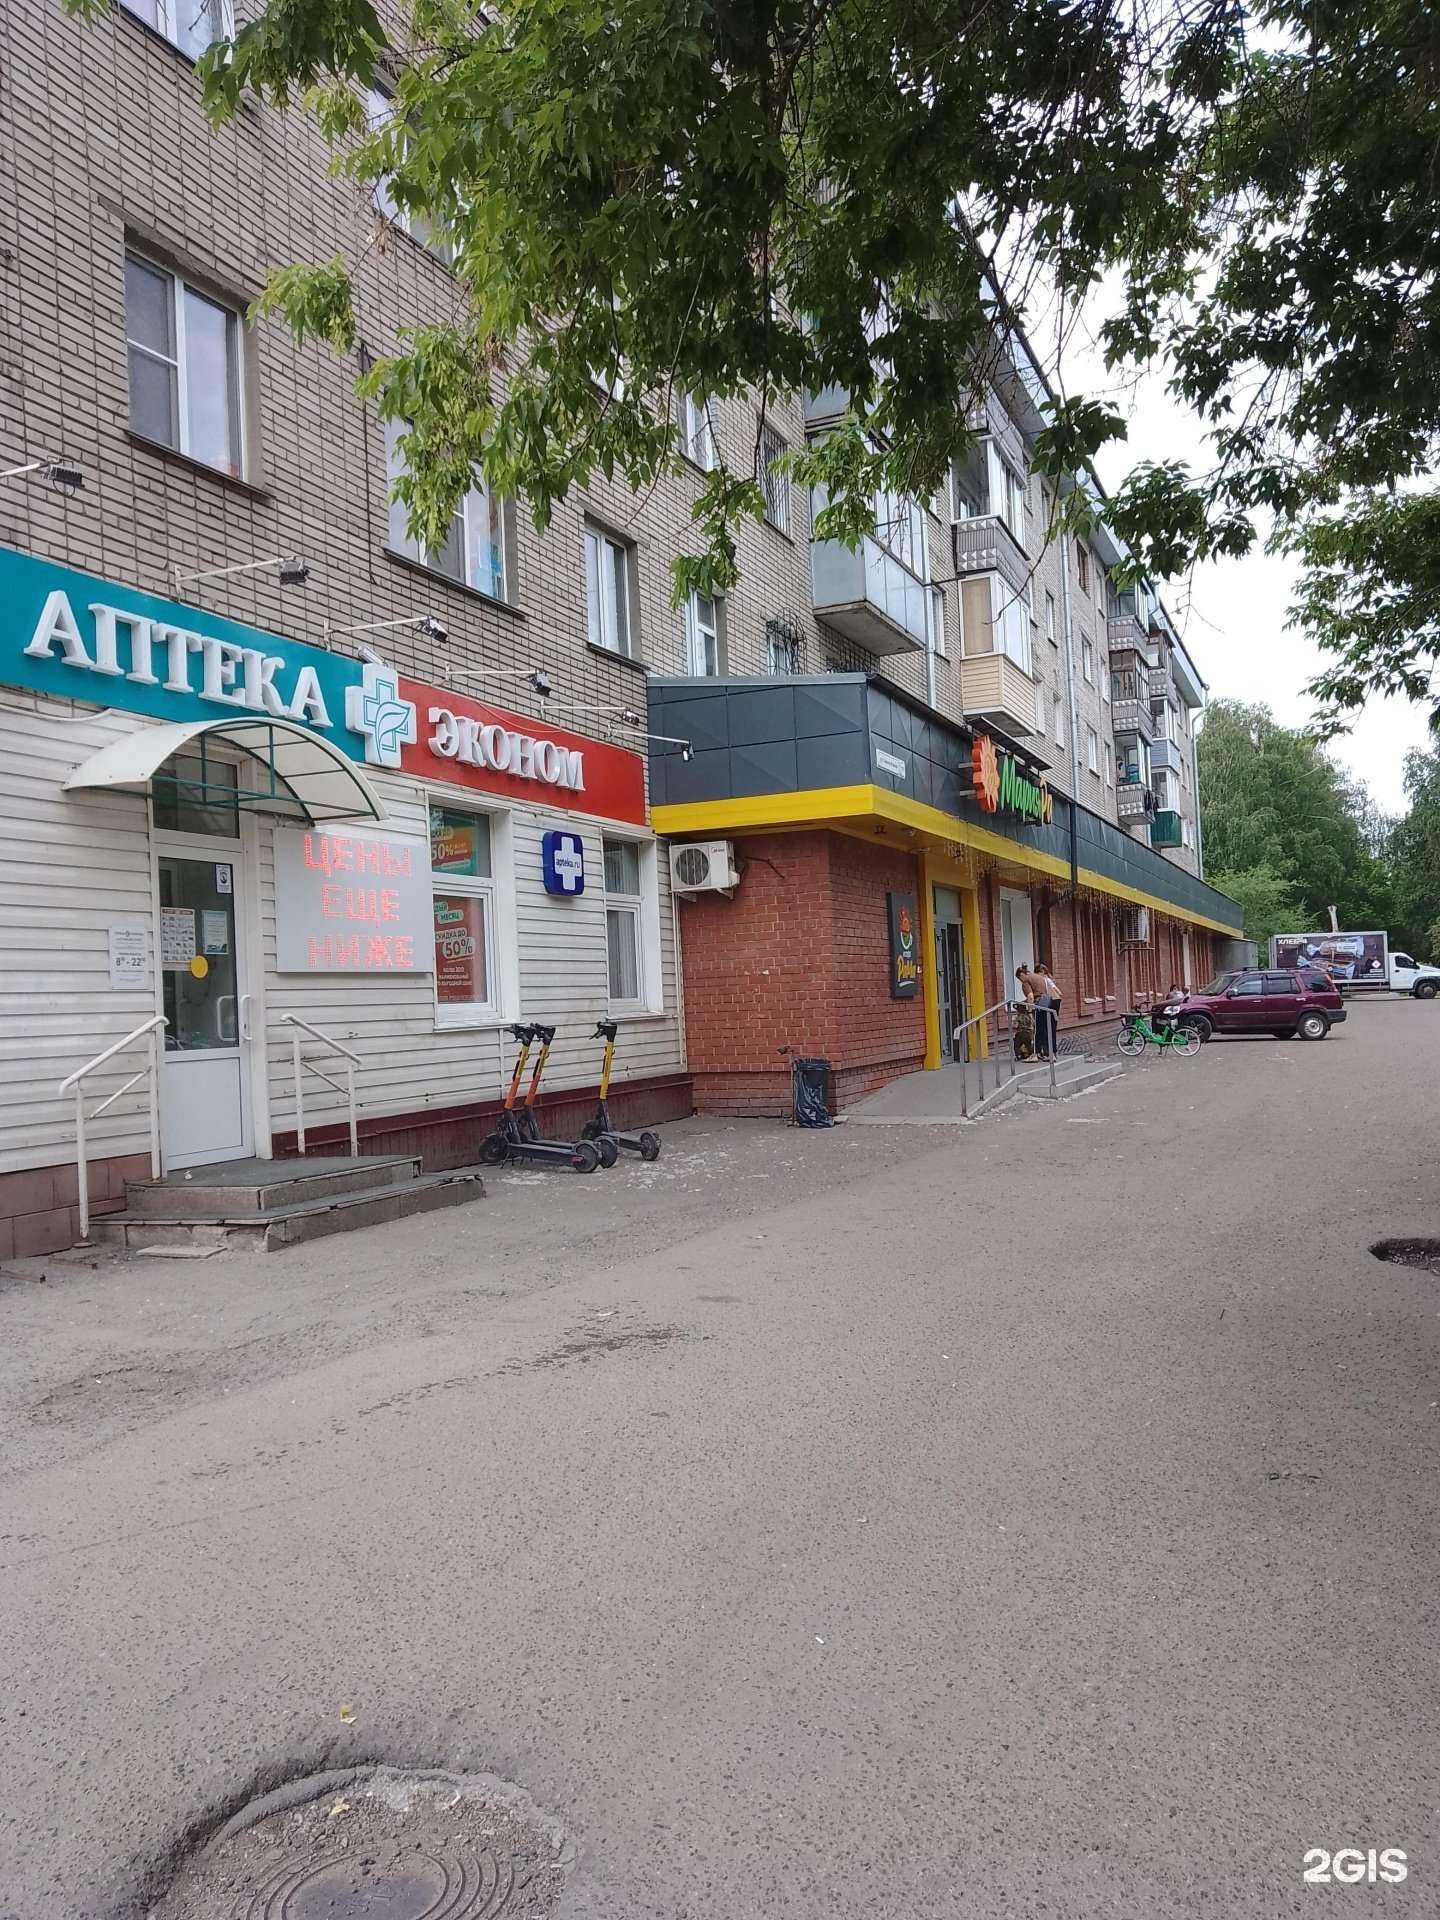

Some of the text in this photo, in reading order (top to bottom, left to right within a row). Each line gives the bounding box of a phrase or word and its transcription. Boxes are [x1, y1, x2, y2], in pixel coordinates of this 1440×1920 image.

[24, 590, 334, 728] АПТЕКА
[428, 707, 585, 791] ЭКОНОМ
[304, 833, 412, 878] ЦЕНЫ
[555, 857, 581, 870] apteka.ru
[321, 881, 400, 928] ЕЩЕ
[308, 934, 414, 969] НИЖЕ
[445, 938, 473, 957] 50%
